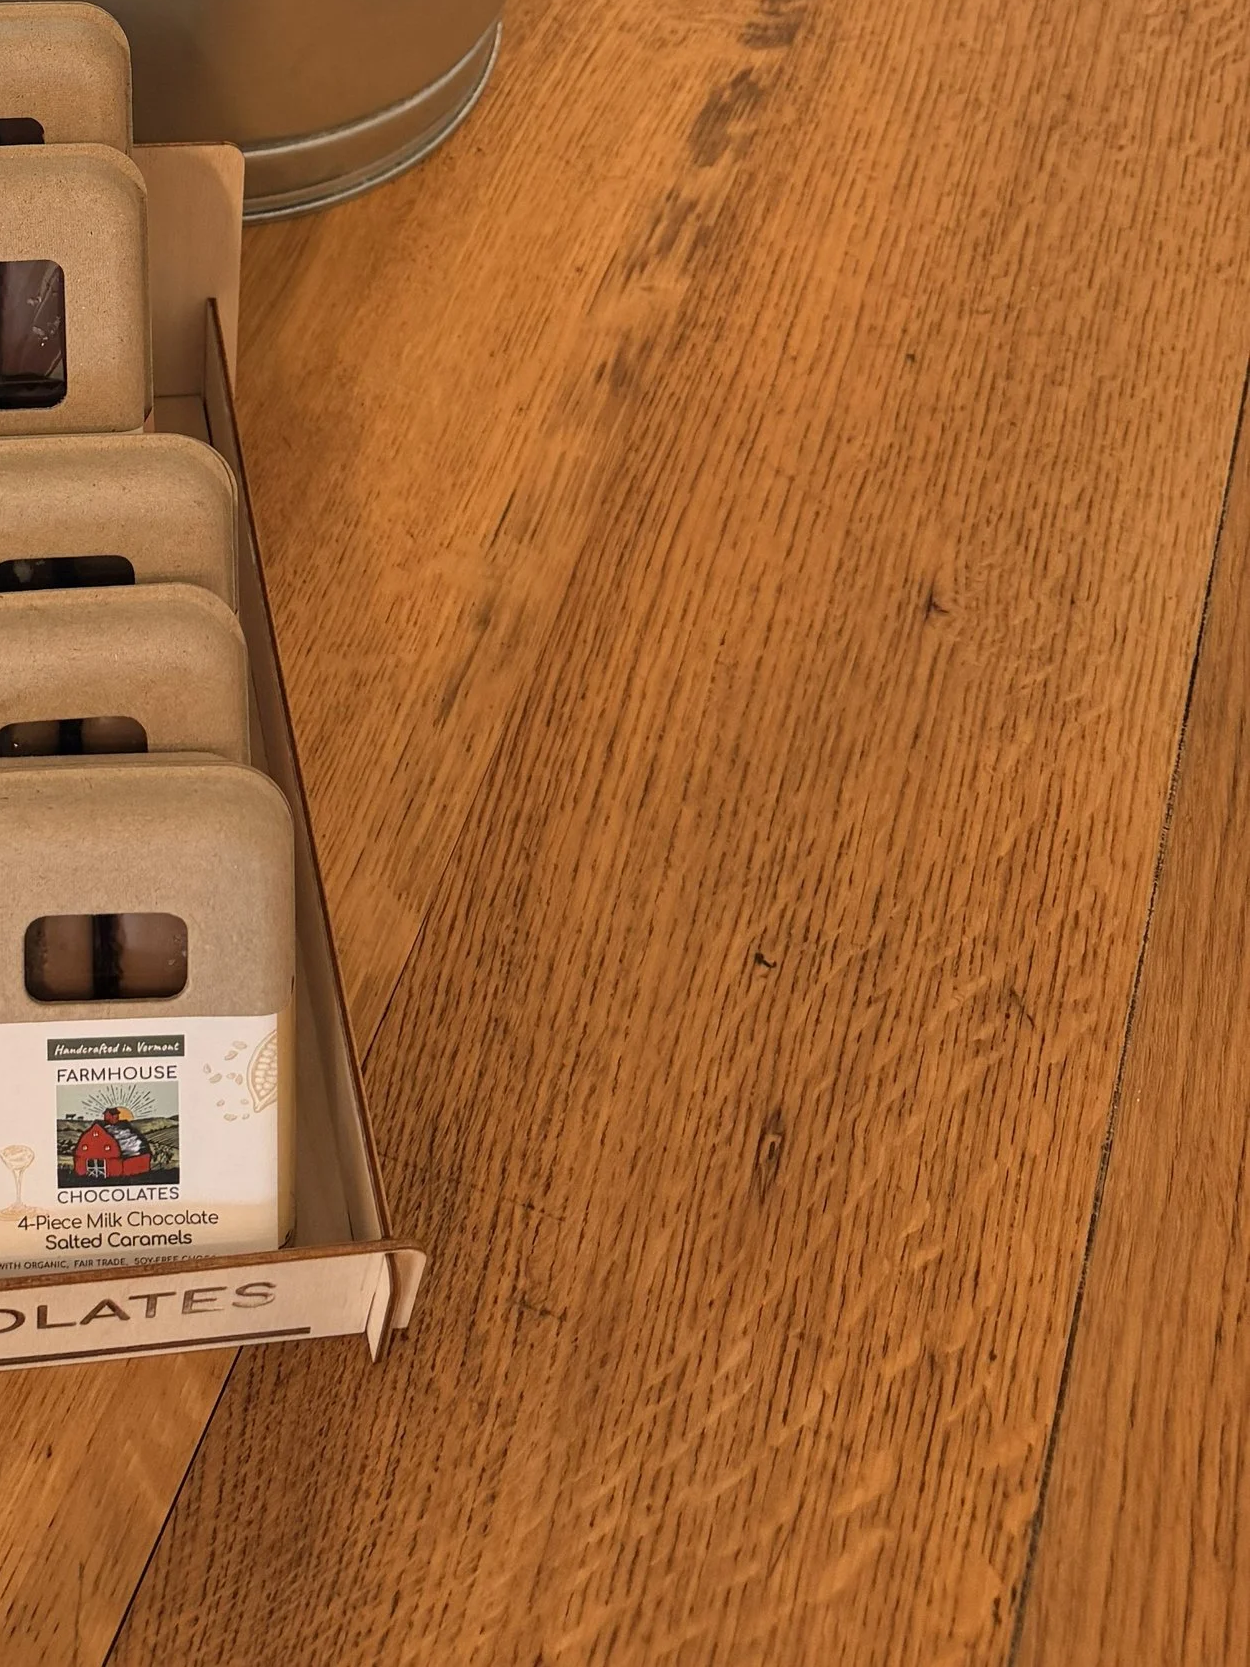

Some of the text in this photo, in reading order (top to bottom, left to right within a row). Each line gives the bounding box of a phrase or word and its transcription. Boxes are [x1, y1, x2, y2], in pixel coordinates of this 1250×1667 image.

[54, 1041, 180, 1056] Handcrafted in Vermont
[57, 1065, 177, 1083] FARMHOUSE
[57, 1186, 179, 1204] CHOCOLATES
[18, 1210, 219, 1230] 4-Piece Milk Chocolate
[46, 1229, 193, 1250] Salted Caramels
[74, 1258, 94, 1268] FAIR
